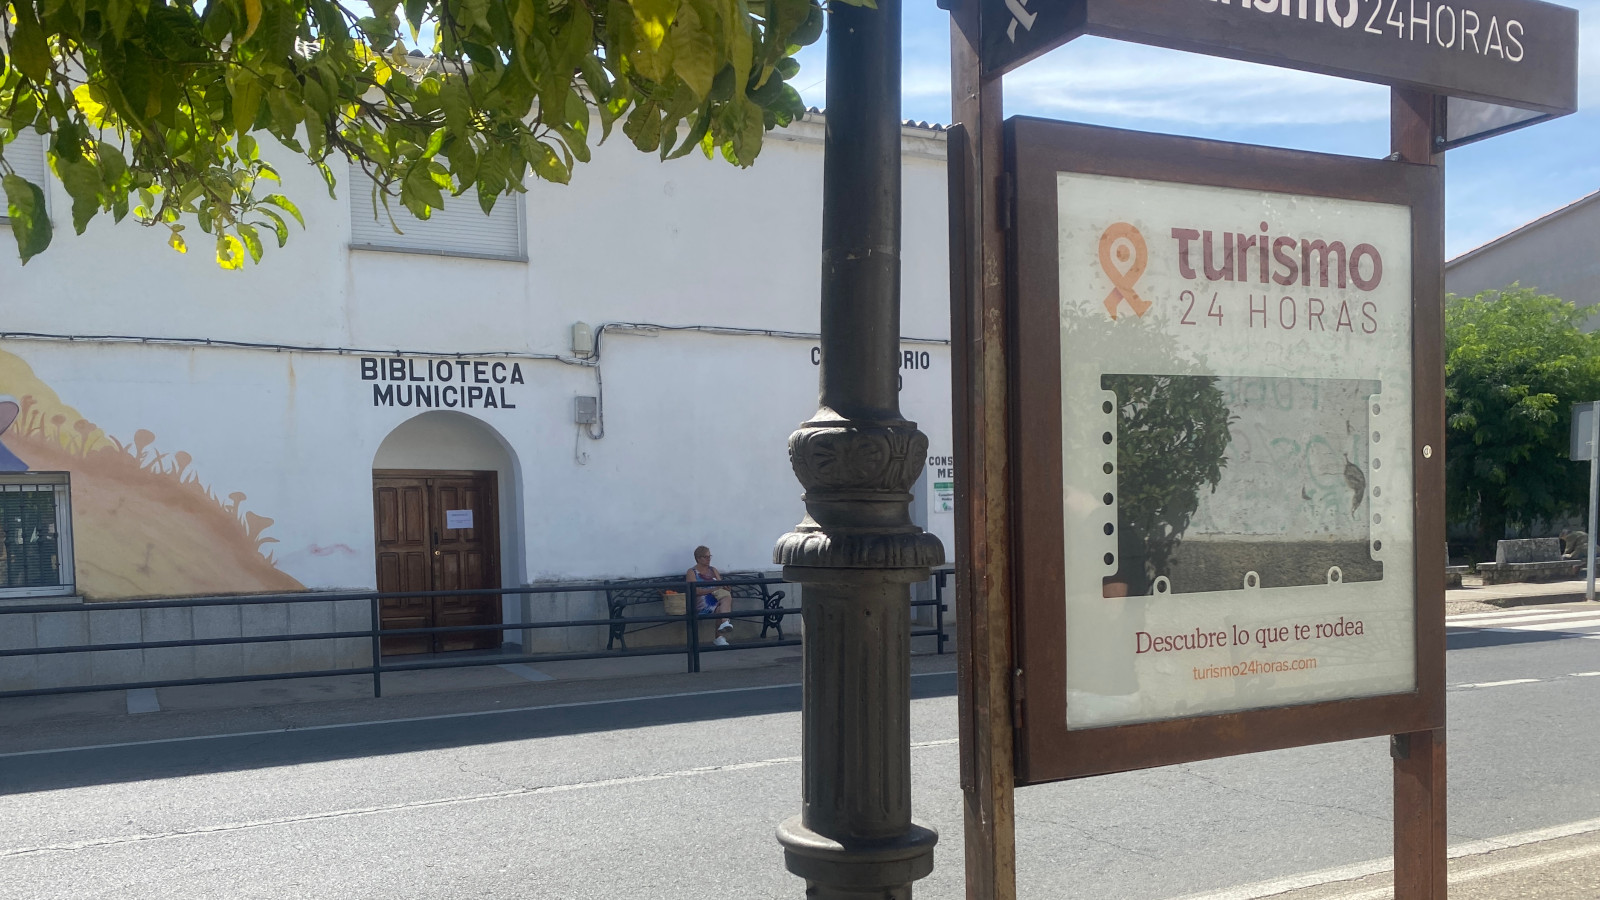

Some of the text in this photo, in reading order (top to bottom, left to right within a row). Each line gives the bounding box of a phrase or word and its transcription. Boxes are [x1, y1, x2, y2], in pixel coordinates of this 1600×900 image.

[1170, 221, 1383, 292] turismo
[1179, 290, 1378, 334] 24 HORAS
[360, 357, 525, 385] BIBLIOTECA
[373, 383, 516, 409] MUNICIPAL
[1135, 616, 1364, 654] Descubre lo que te rodea
[1192, 657, 1317, 681] turismo24horas.com
